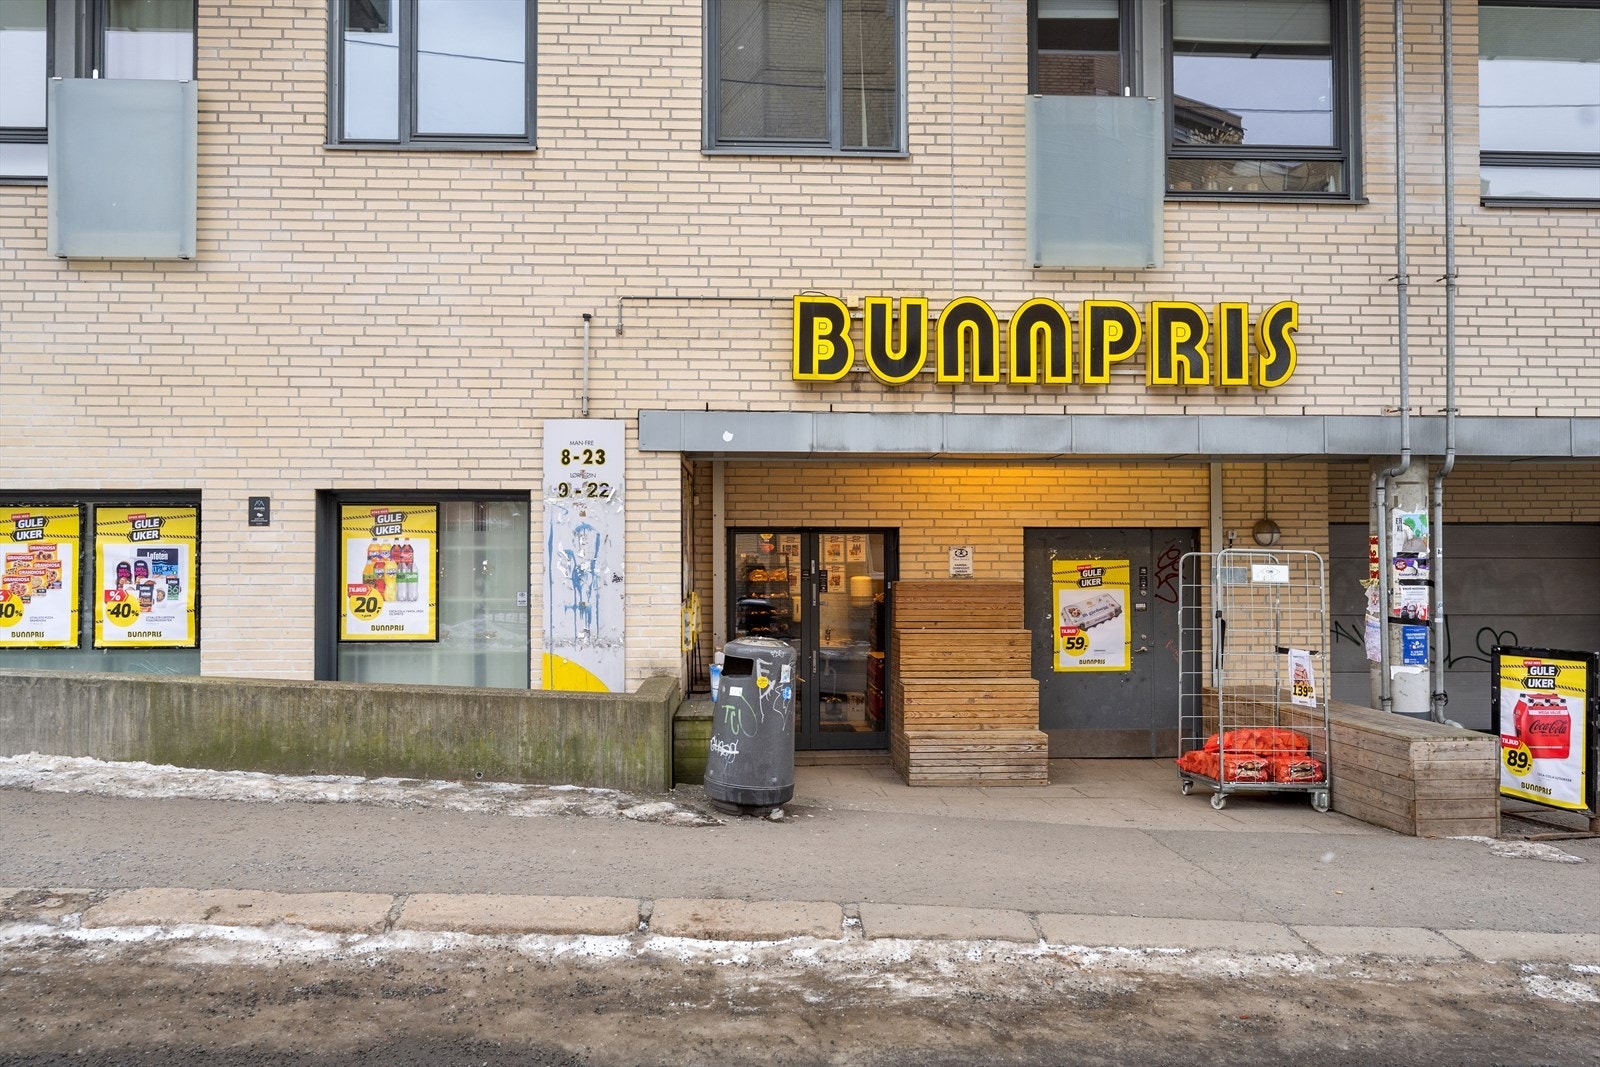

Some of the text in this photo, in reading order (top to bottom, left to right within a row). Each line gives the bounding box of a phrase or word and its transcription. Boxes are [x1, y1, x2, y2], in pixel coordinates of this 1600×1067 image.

[793, 296, 1299, 388] BUNNPRIS
[18, 517, 44, 529] GULE
[134, 518, 160, 529] GULE
[377, 513, 402, 524] GULE
[16, 529, 42, 541] UKER
[132, 530, 158, 541] UKER
[376, 525, 401, 536] UKER
[1082, 568, 1102, 577] GULE
[1082, 578, 1102, 586] UKER
[1530, 666, 1555, 676] GULE
[1528, 678, 1554, 688] UKER
[1521, 782, 1552, 795] BUNNPRIS
